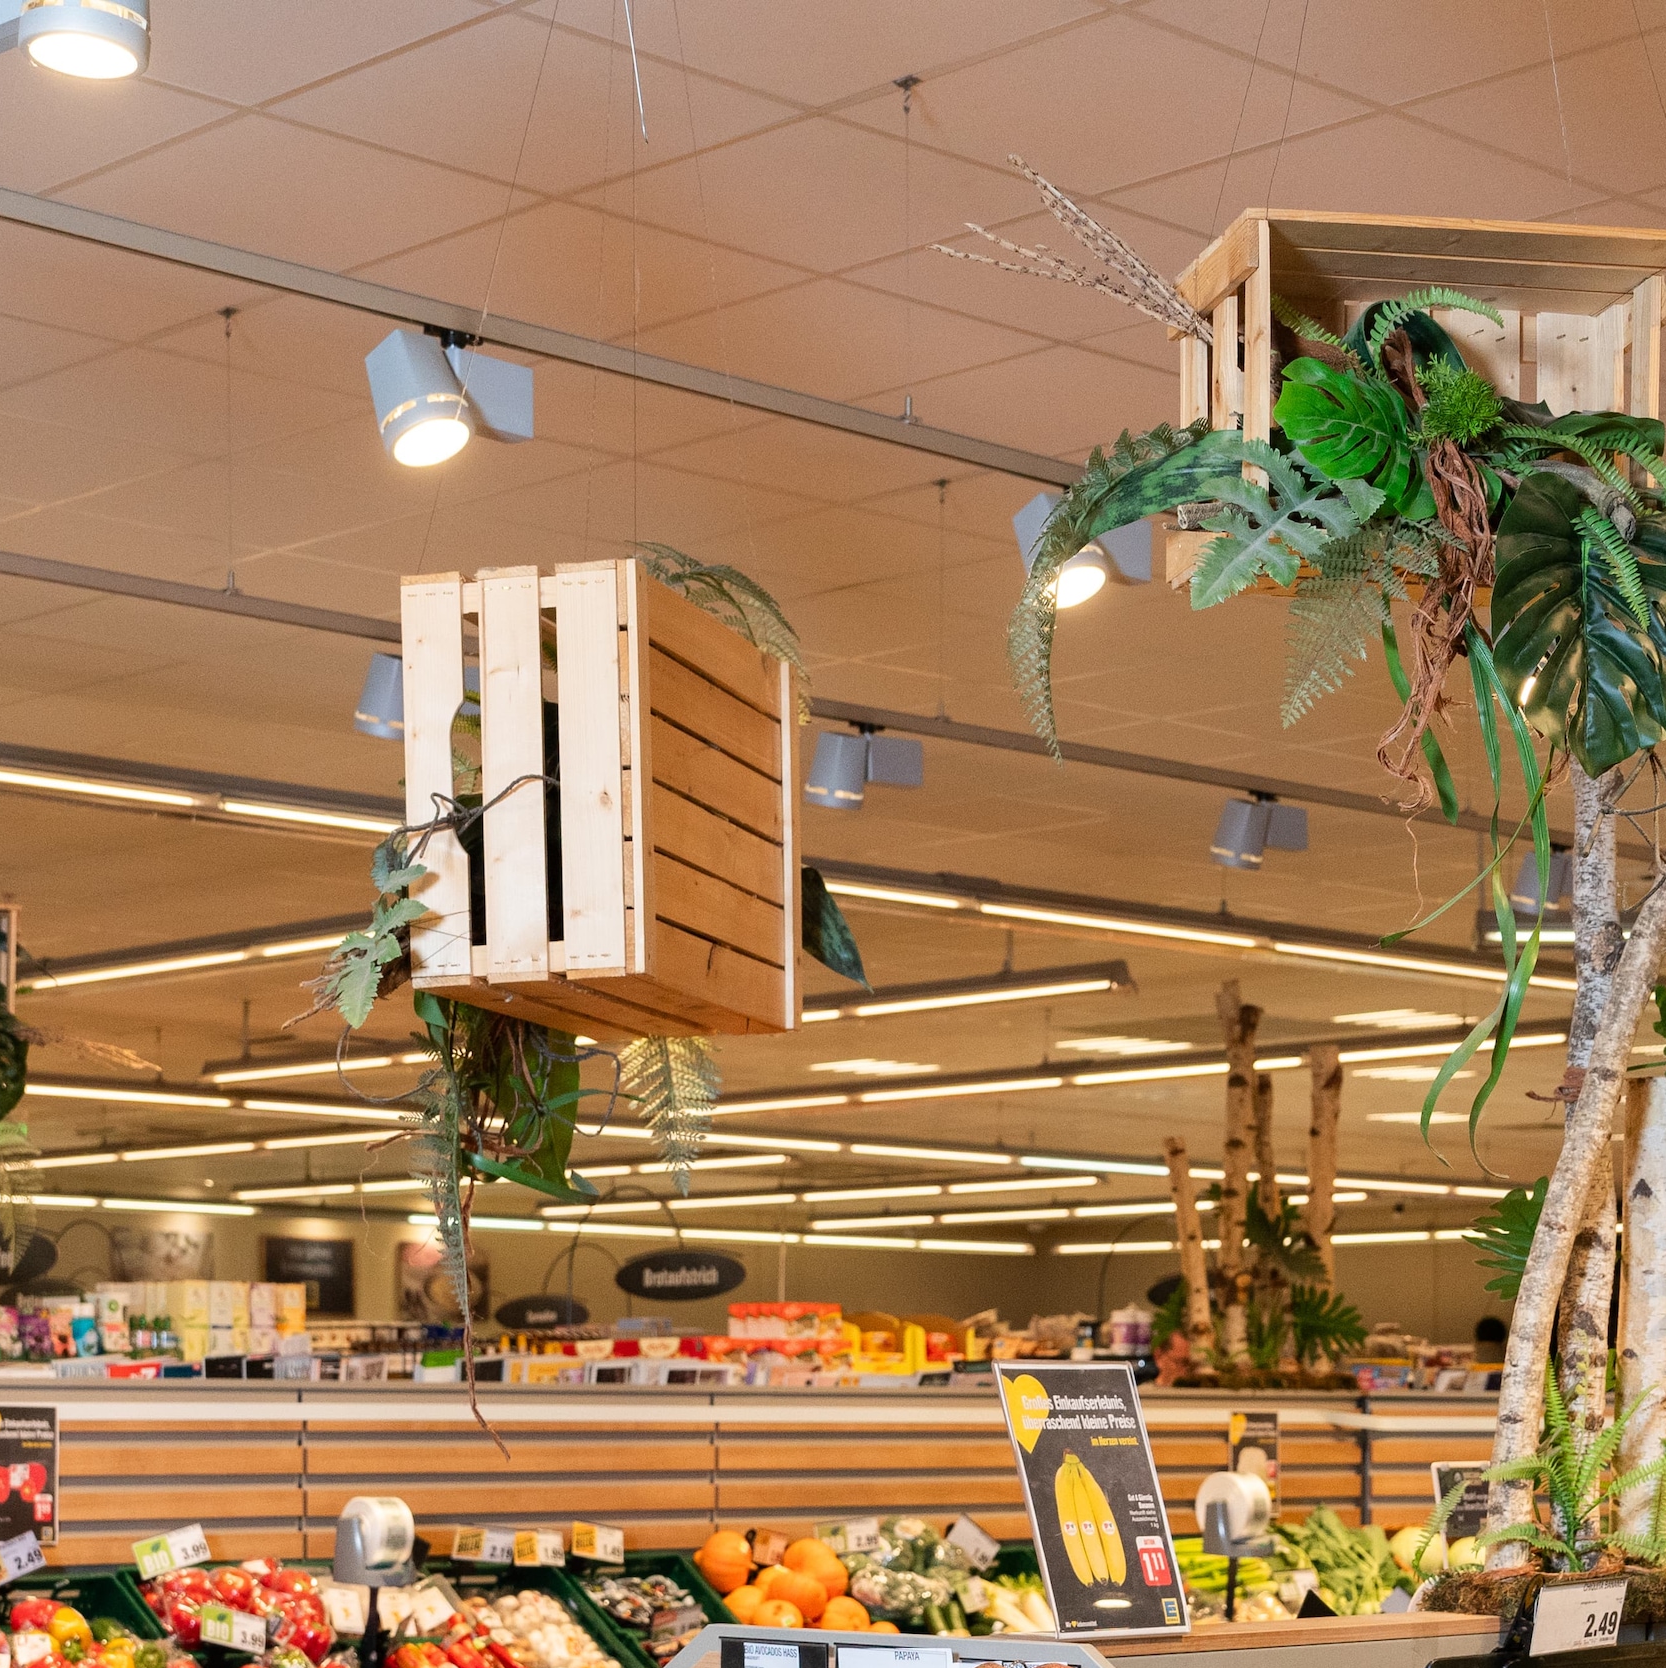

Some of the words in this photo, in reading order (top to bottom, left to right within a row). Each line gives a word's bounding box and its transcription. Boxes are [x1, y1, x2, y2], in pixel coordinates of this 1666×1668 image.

[1021, 1395, 1054, 1411] Großes
[1053, 1394, 1127, 1412] Einkaufserlebnis,
[1023, 1414, 1081, 1430] überraschend
[1082, 1415, 1109, 1430] kleine
[1109, 1414, 1137, 1430] Preise
[14, 1549, 43, 1571] 2.49
[141, 1551, 171, 1571] BIO
[179, 1542, 208, 1562] 3.99
[204, 1617, 231, 1641] BIO
[1584, 1611, 1618, 1638] 2.49
[240, 1633, 266, 1649] 3.99
[744, 1644, 756, 1655] BIO
[755, 1646, 782, 1657] AVOCADOS
[783, 1647, 798, 1659] HASS
[894, 1650, 920, 1661] PAPAYA
